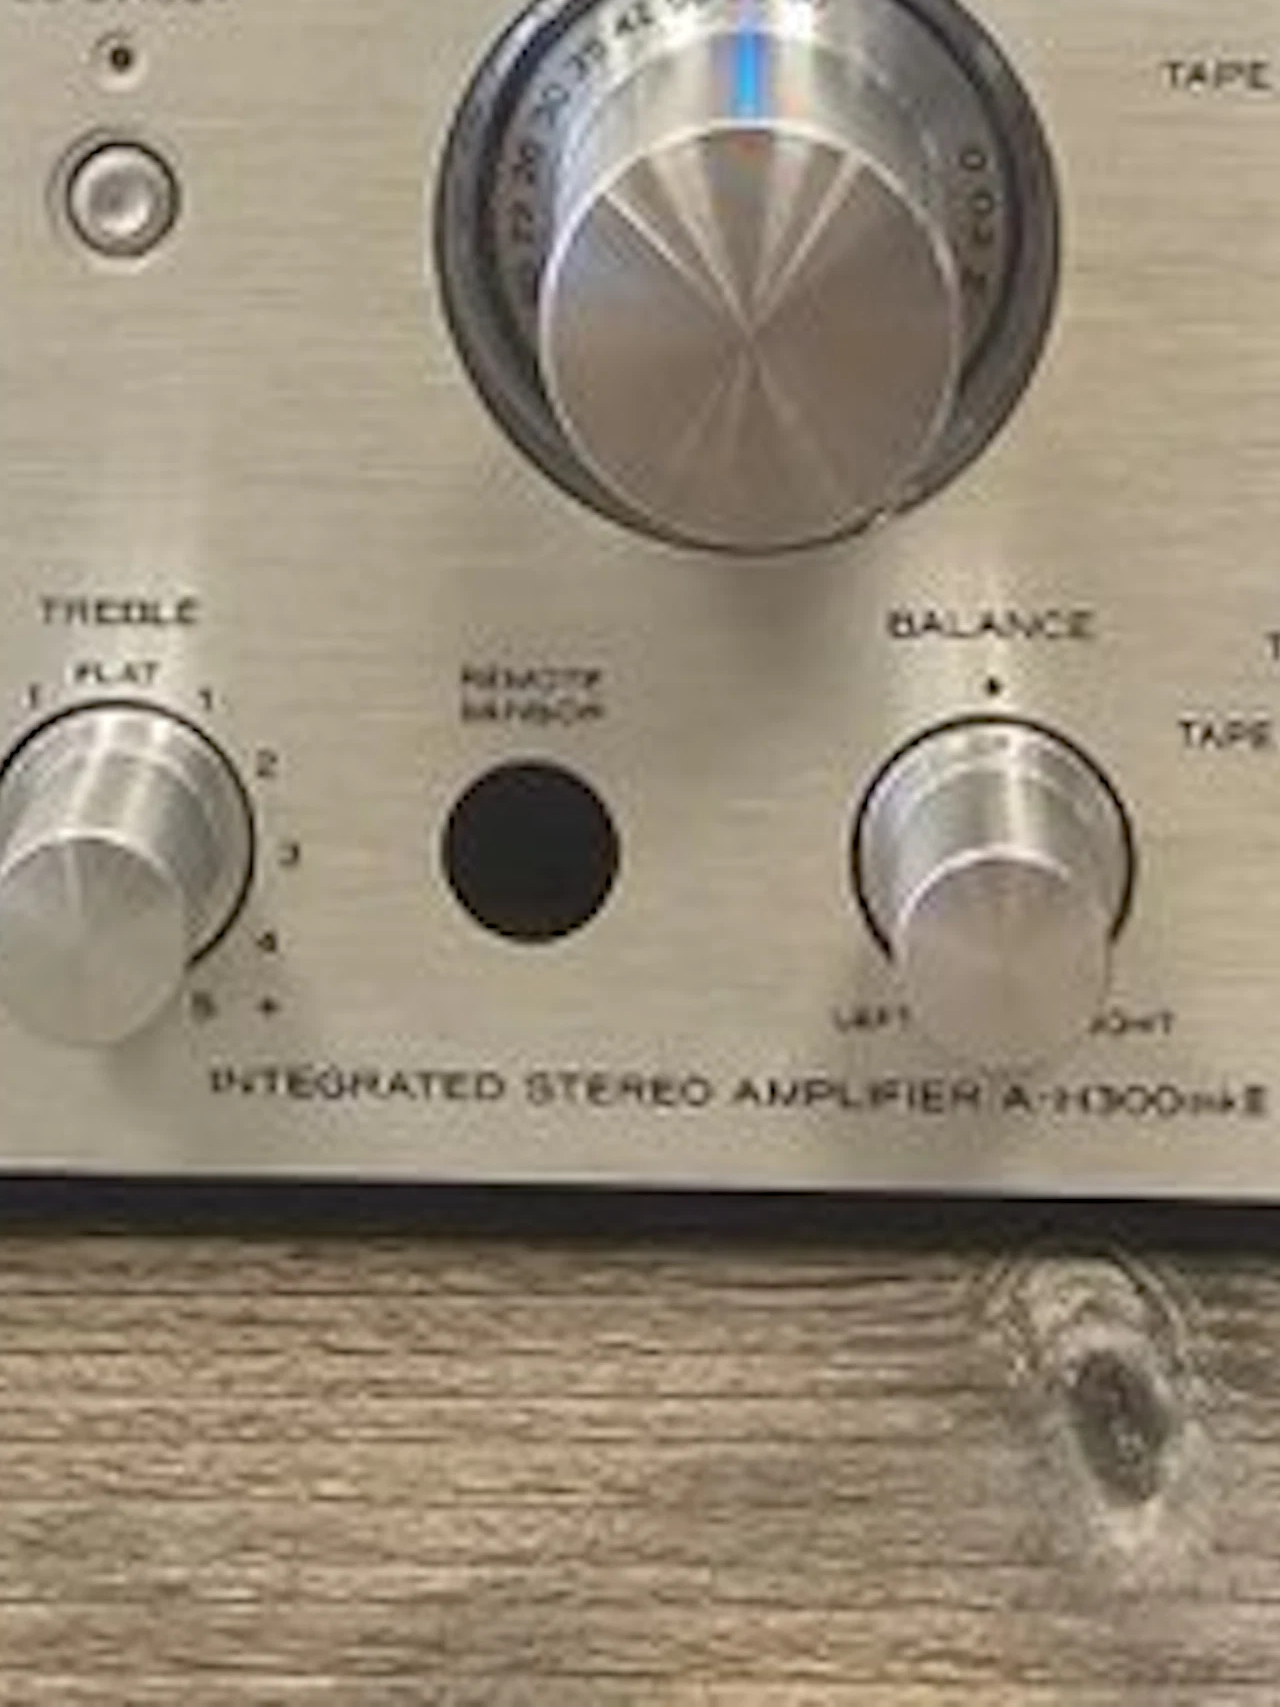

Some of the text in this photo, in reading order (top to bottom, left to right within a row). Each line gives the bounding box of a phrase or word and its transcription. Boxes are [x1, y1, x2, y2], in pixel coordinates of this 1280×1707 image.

[1165, 61, 1280, 91] TAPE
[41, 597, 202, 626] TREBLE
[888, 609, 1097, 640] BALANCE
[74, 661, 160, 684] FLAT
[1178, 720, 1270, 752] TAPE
[208, 1067, 508, 1103] INTEGRATED
[526, 1070, 714, 1108] STEREO
[730, 1078, 982, 1114] AMPLIFIER
